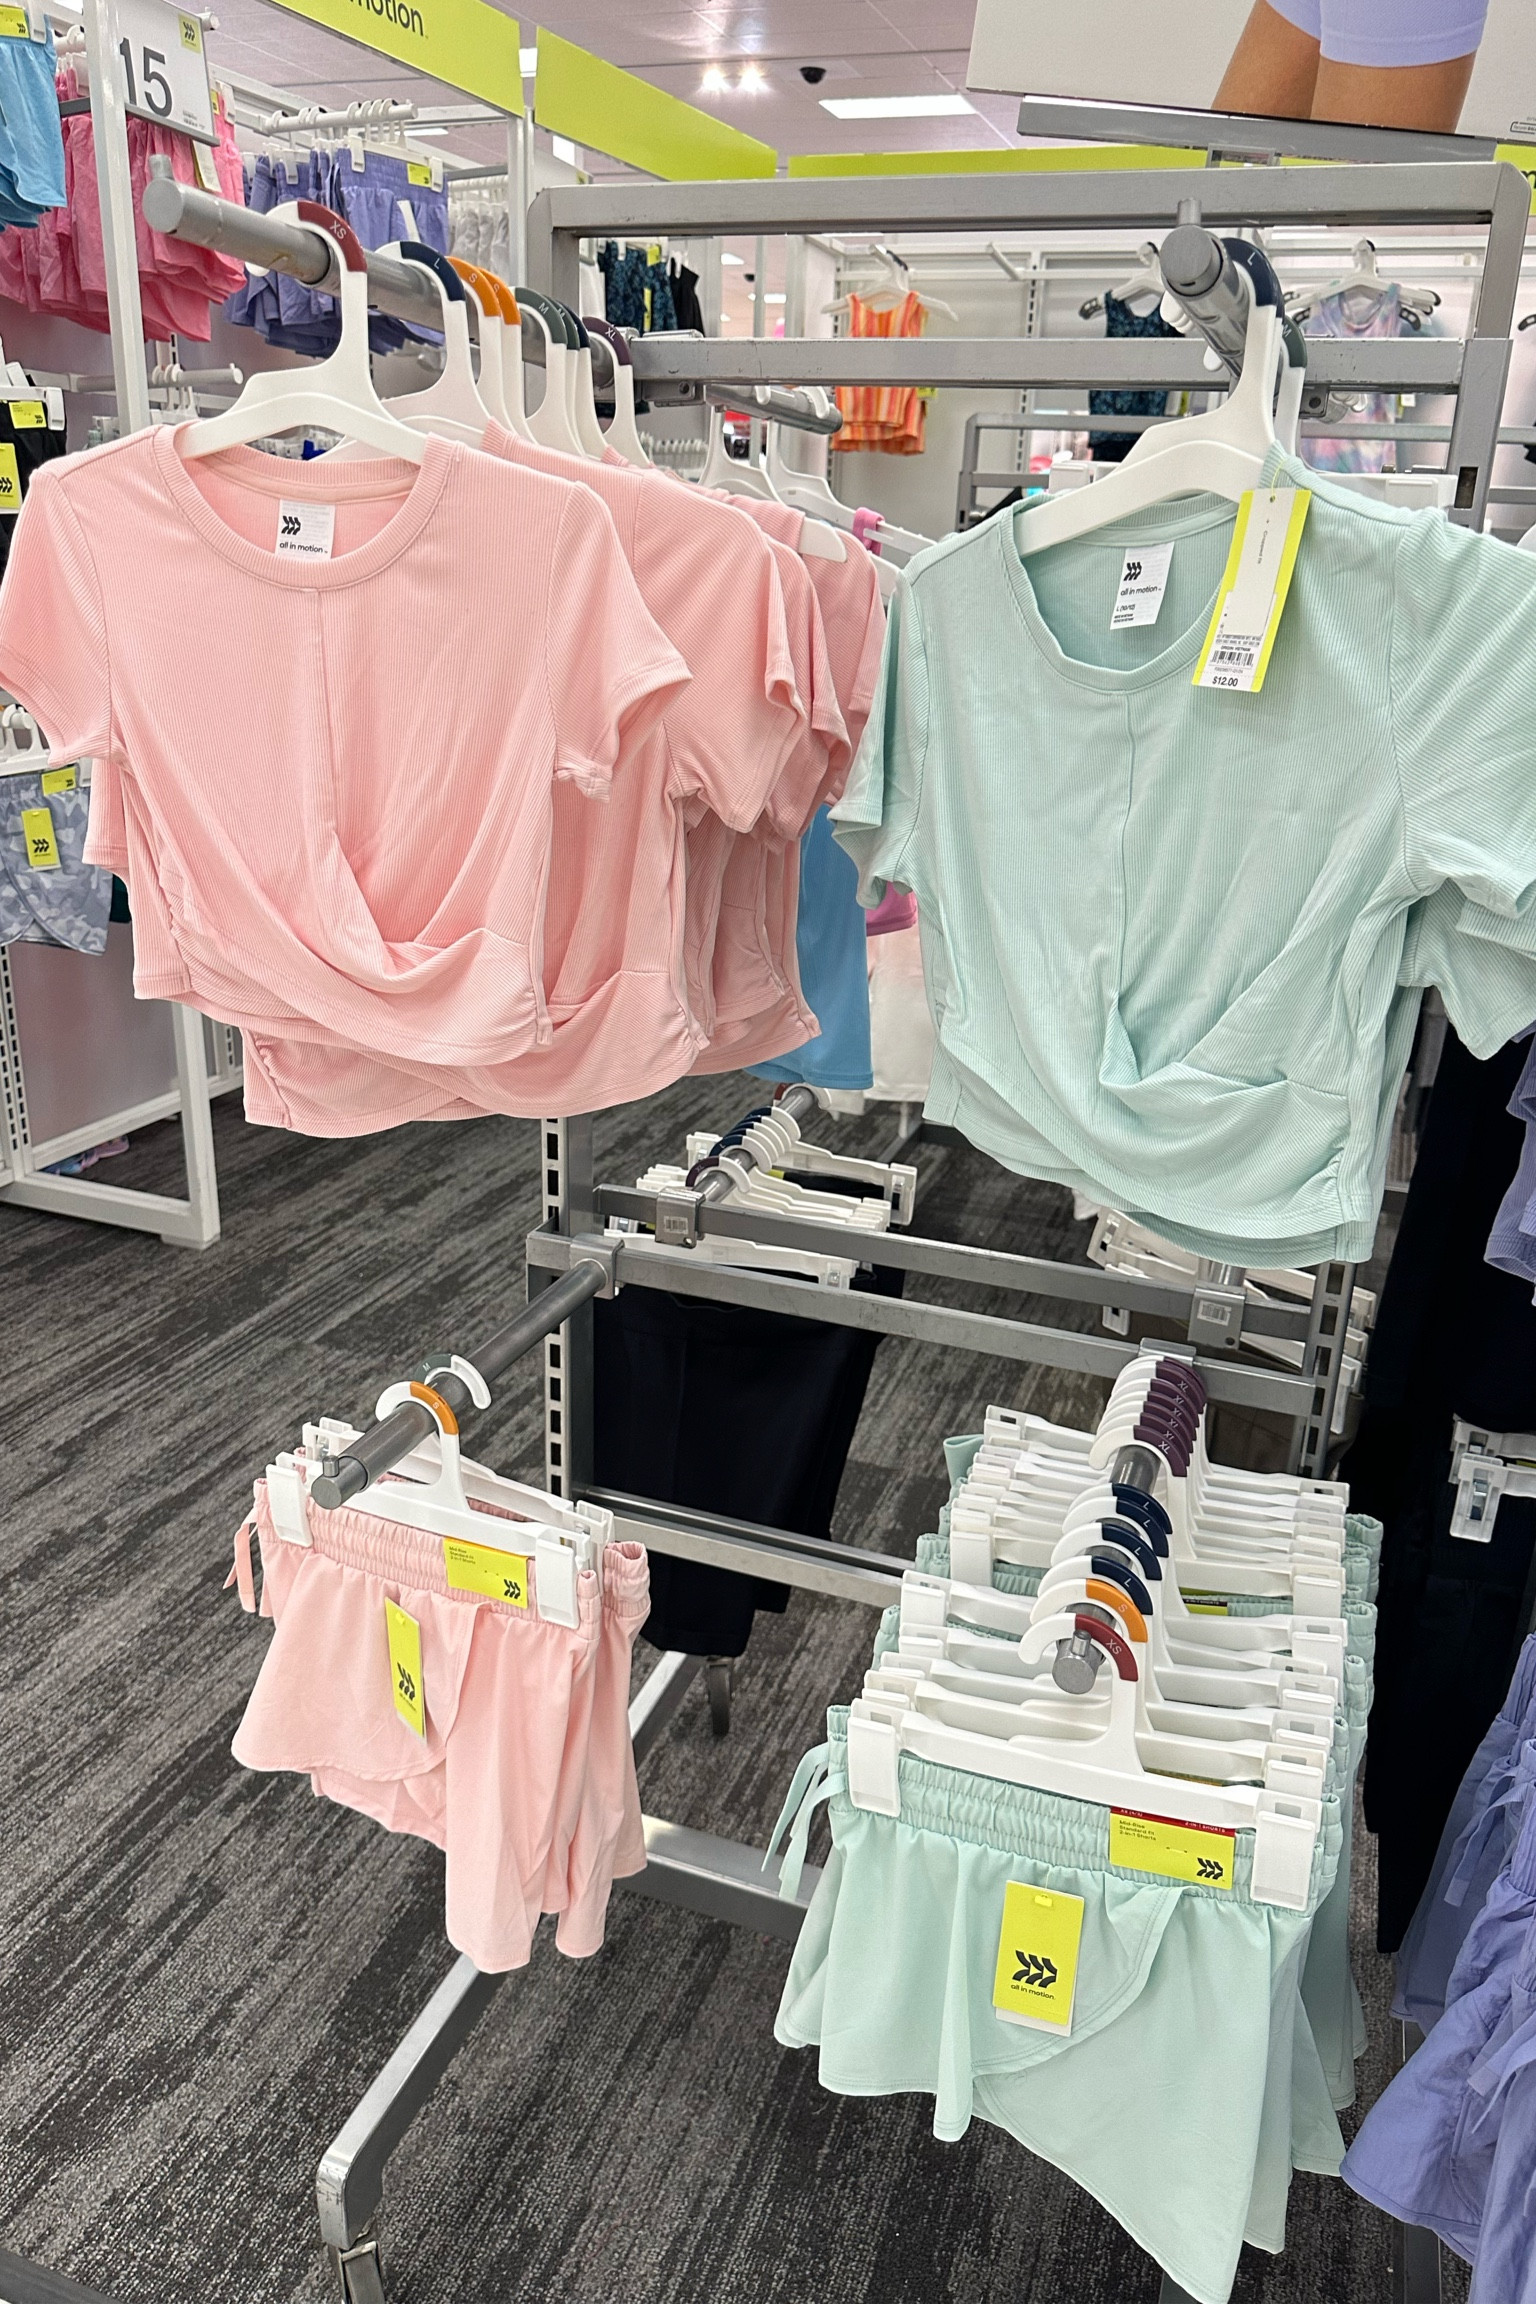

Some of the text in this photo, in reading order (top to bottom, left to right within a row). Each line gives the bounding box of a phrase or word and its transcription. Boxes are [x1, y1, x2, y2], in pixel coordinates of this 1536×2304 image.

[120, 37, 172, 117] 15
[329, 220, 348, 240] XS
[433, 257, 440, 269] L
[1247, 252, 1256, 266] L
[468, 273, 478, 283] S
[538, 302, 549, 315] M
[605, 327, 617, 341] XL
[279, 541, 289, 549] all
[289, 541, 297, 550] in
[1120, 587, 1129, 596] all
[1129, 587, 1136, 595] in
[1212, 675, 1239, 687] $12.00
[422, 1362, 431, 1372] M
[1177, 1380, 1189, 1392] XL
[432, 1401, 440, 1410] S
[1158, 1440, 1172, 1455] XL
[1142, 1501, 1150, 1511] L
[1142, 1519, 1151, 1529] L
[1133, 1546, 1141, 1556] L
[1123, 1578, 1132, 1588] L
[1118, 1604, 1128, 1613] S
[1105, 1638, 1122, 1656] XS
[1119, 1825, 1147, 1834] Standard
[1136, 1832, 1157, 1841] Shorts
[1020, 1985, 1028, 1993] in
